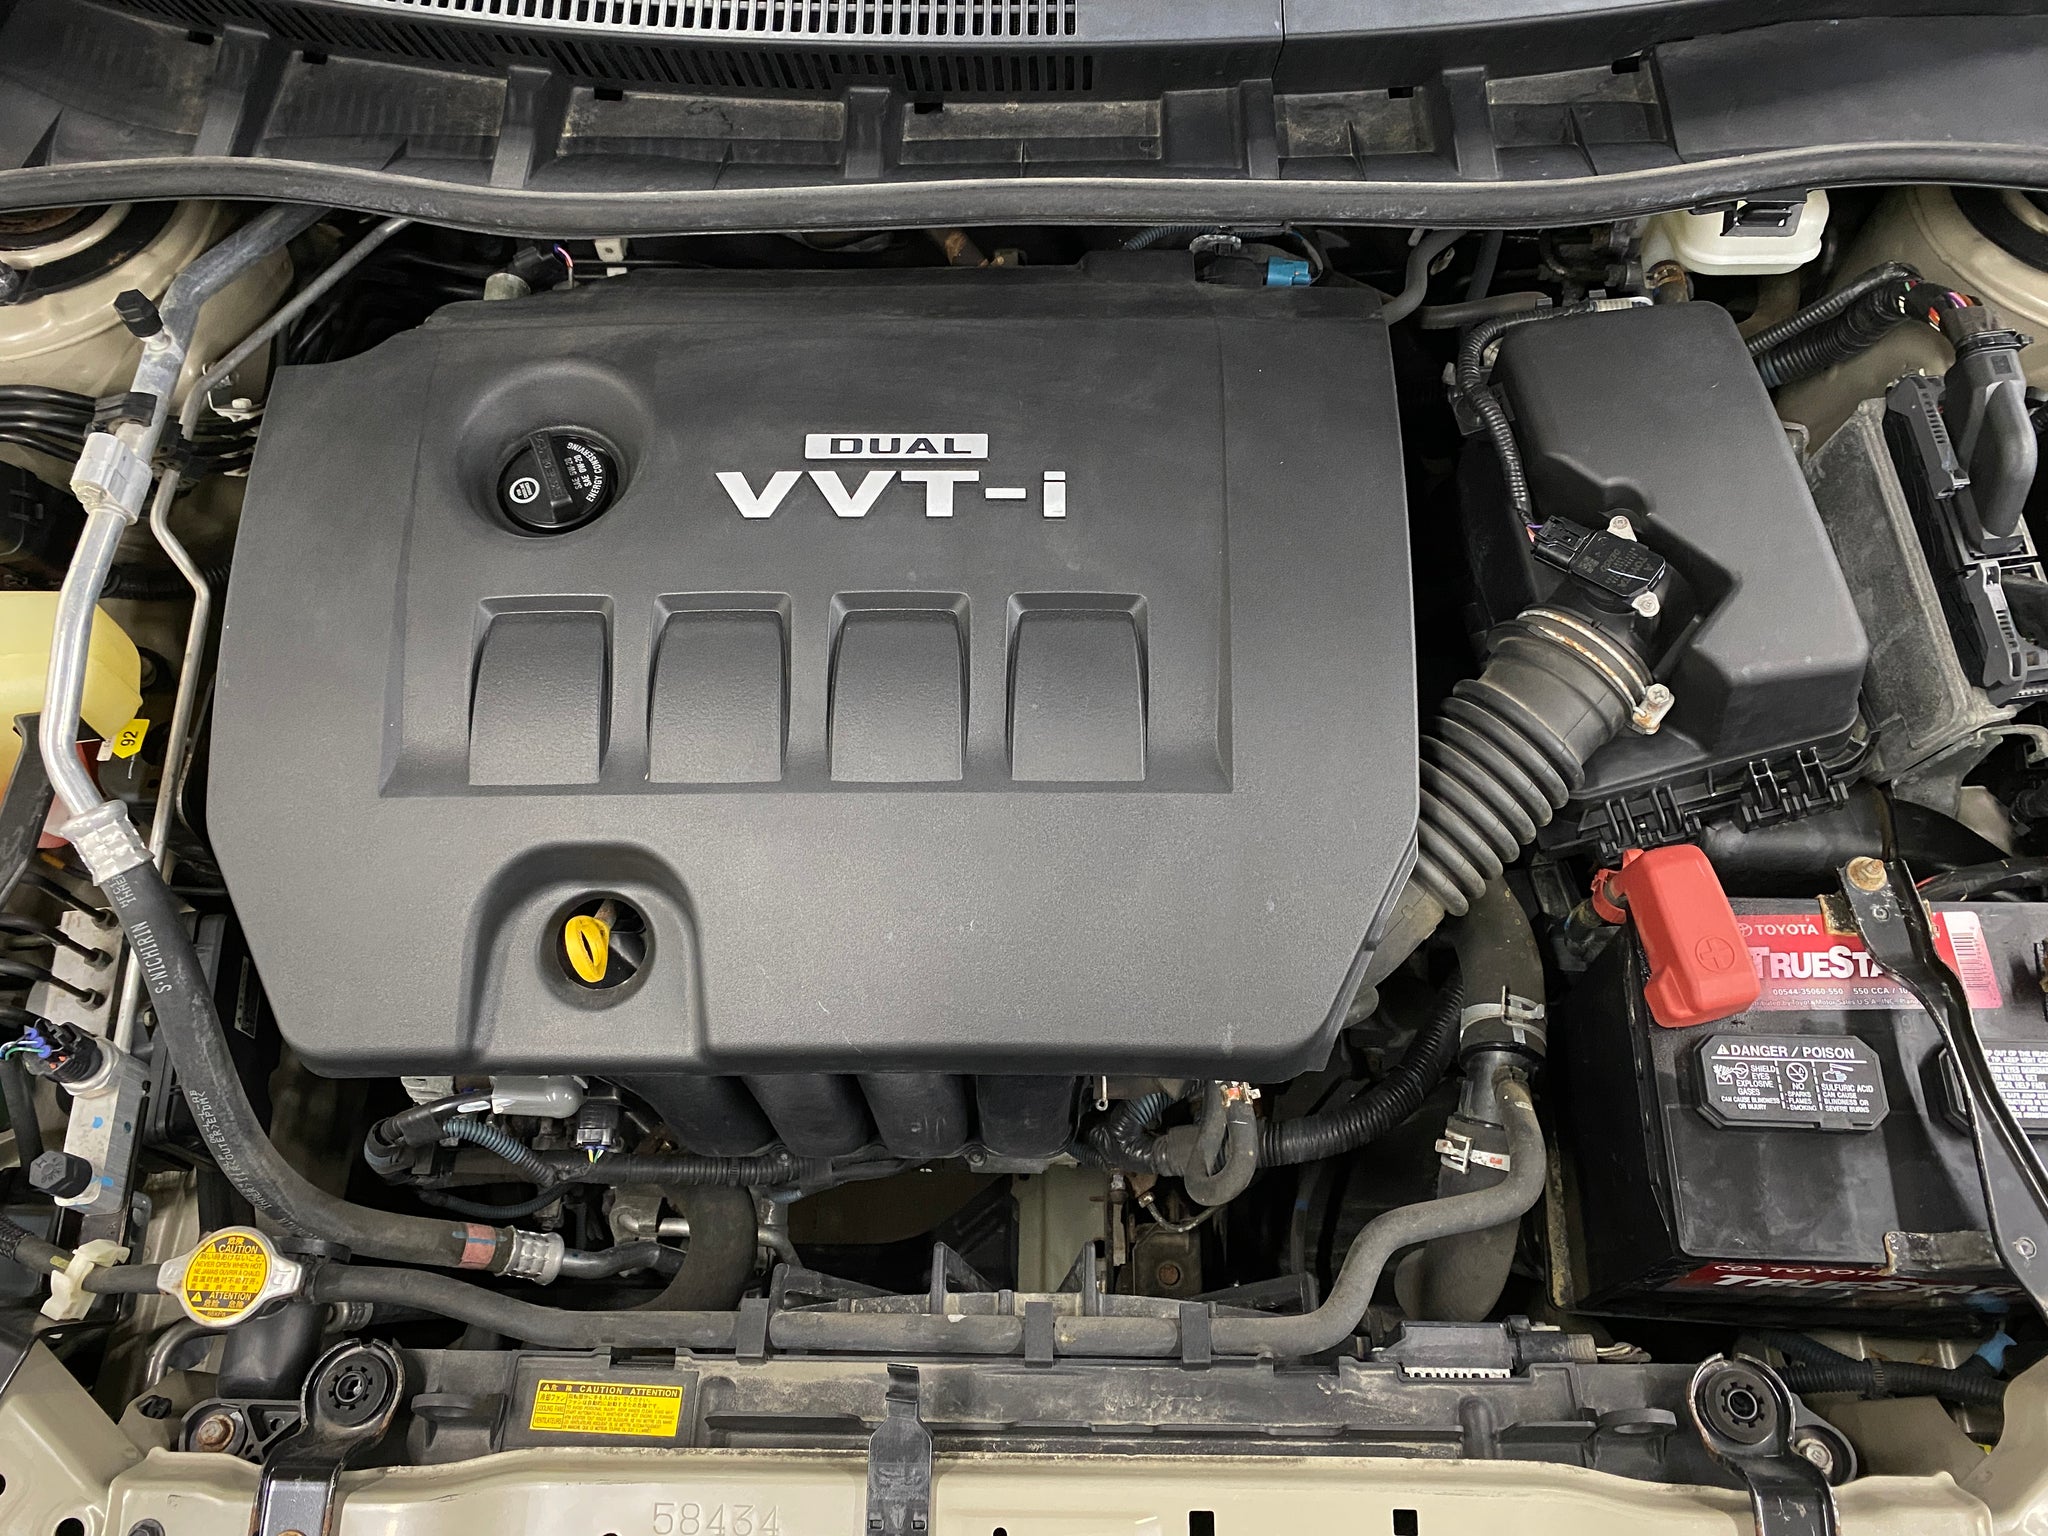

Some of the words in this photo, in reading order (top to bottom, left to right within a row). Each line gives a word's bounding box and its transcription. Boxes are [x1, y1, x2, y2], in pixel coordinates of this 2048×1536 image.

[830, 438, 971, 454] DUAL
[566, 442, 603, 474] CONSERVING
[572, 477, 583, 490] SAE
[581, 474, 593, 487] SAE
[585, 475, 603, 502] ENERGY
[715, 471, 1066, 518] VVT-i
[121, 731, 139, 746] 92
[1754, 924, 1819, 936] TOYOTA
[1853, 987, 1869, 995] 550
[1871, 987, 1890, 995] CCA
[1730, 1045, 1788, 1057] DANGER
[1791, 1046, 1799, 1058] /
[1803, 1047, 1855, 1059] POISON
[1750, 1065, 1775, 1073] SHIELD
[1736, 1080, 1774, 1088] EXPLOSIVE
[1792, 1083, 1805, 1091] NO
[1821, 1084, 1856, 1092] SULFURIC
[1857, 1085, 1873, 1093] ACID
[1738, 1088, 1761, 1096] GASES
[218, 1244, 258, 1254] CAUTION
[209, 1291, 252, 1301] ATTENTION
[579, 1385, 623, 1395] CAUTION
[630, 1387, 678, 1398] ATTENTION
[653, 1502, 780, 1536] 58434
